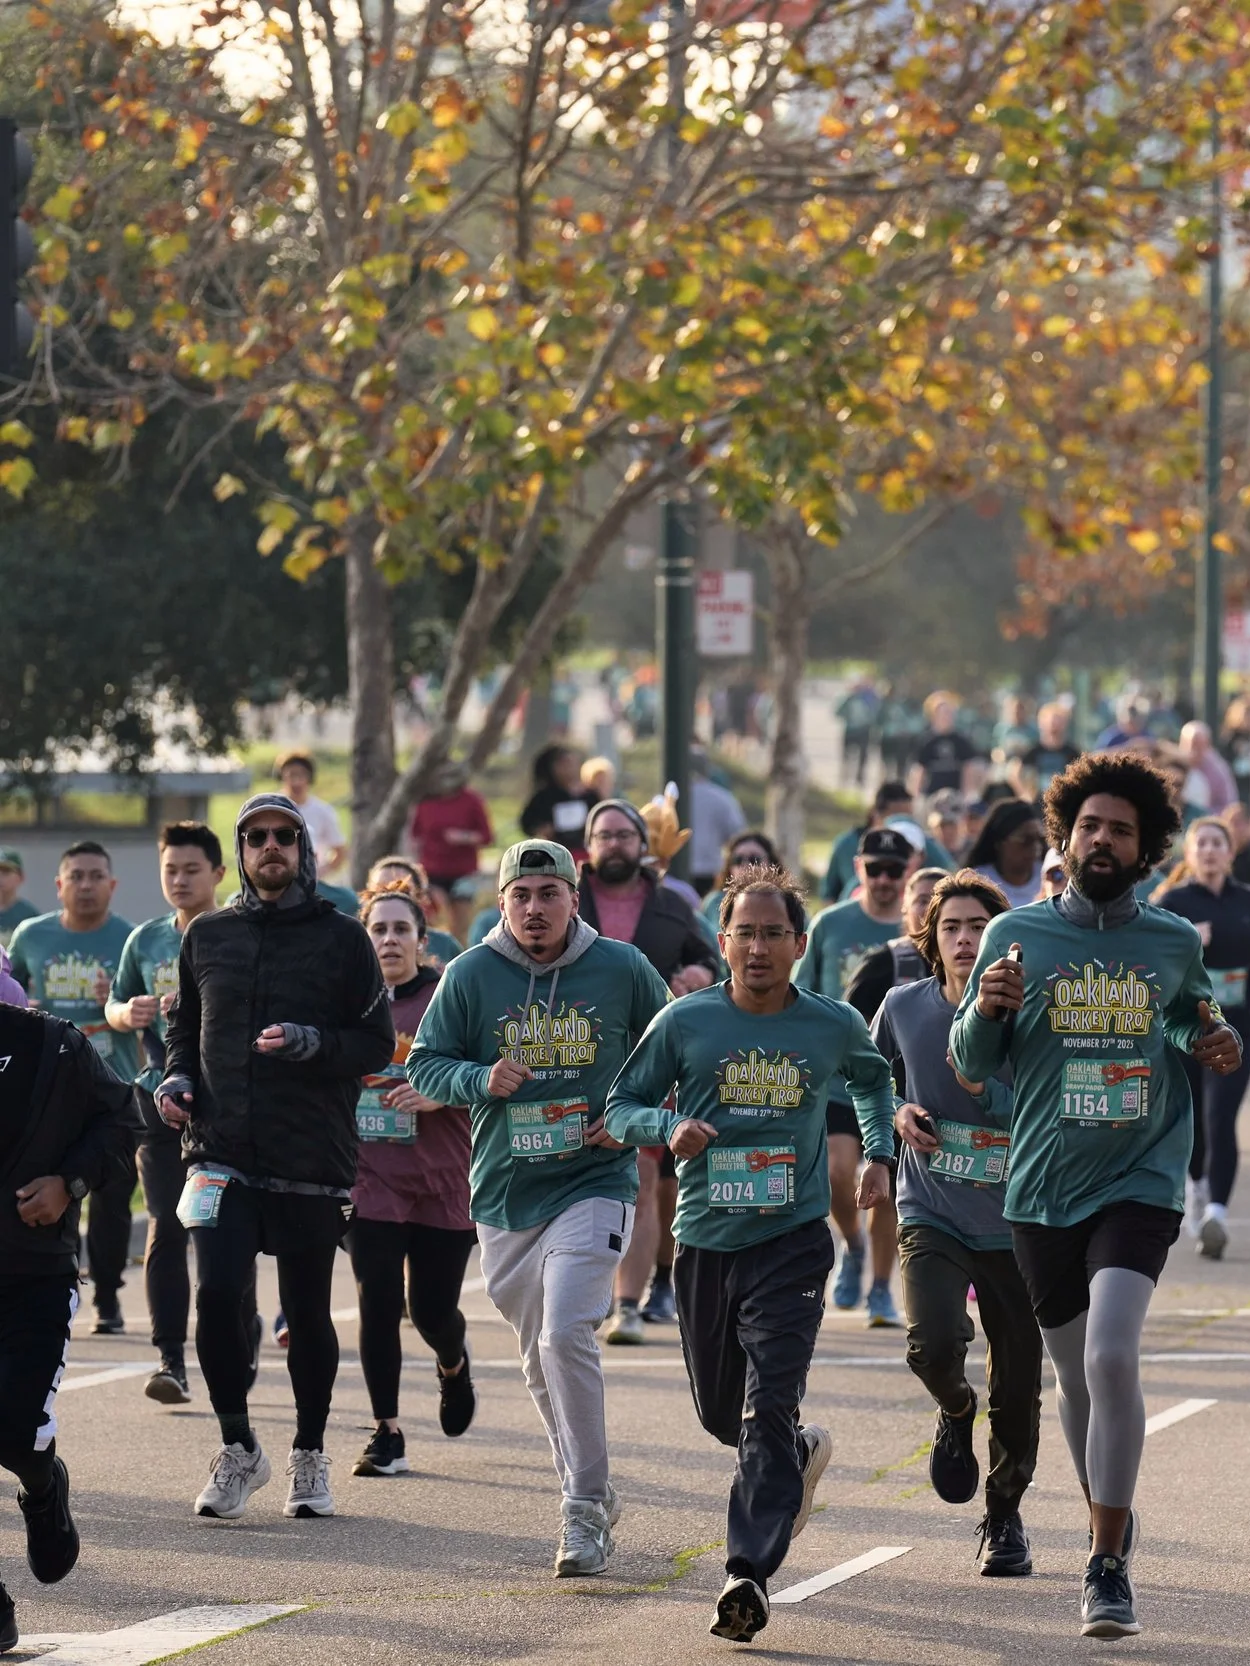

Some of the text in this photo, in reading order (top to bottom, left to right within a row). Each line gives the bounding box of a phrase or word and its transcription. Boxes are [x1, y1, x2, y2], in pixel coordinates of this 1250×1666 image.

[1055, 964, 1149, 1010] OAKLAND
[505, 1005, 591, 1046] OAKLAND
[1048, 1008, 1153, 1034] TURKEY TROT
[1063, 1038, 1099, 1048] NOVEMBER
[1117, 1039, 1134, 1049] 2025
[500, 1043, 597, 1067] TURKEY TROT
[726, 1050, 799, 1087] OAKLAND
[1066, 1062, 1102, 1074] OAKLAND
[1126, 1059, 1144, 1069] 2025
[564, 1070, 580, 1078] 2025
[1066, 1074, 1102, 1083] TURKEY TROT
[1085, 1084, 1105, 1092] DADDY
[719, 1084, 803, 1107] TURKEY TROT
[563, 1098, 581, 1107] 2025
[1063, 1093, 1109, 1116] 1154
[510, 1105, 543, 1117] OAKLAND
[729, 1107, 758, 1116] NOVEMBER
[357, 1116, 385, 1131] 436
[941, 1124, 972, 1139] OAKLAND
[511, 1133, 553, 1151] 4964
[712, 1150, 746, 1162] OAKLAND
[769, 1147, 788, 1155] 2025
[712, 1162, 746, 1172] TURKEY TROT
[932, 1150, 975, 1174] 2187
[711, 1182, 754, 1201] 2074
